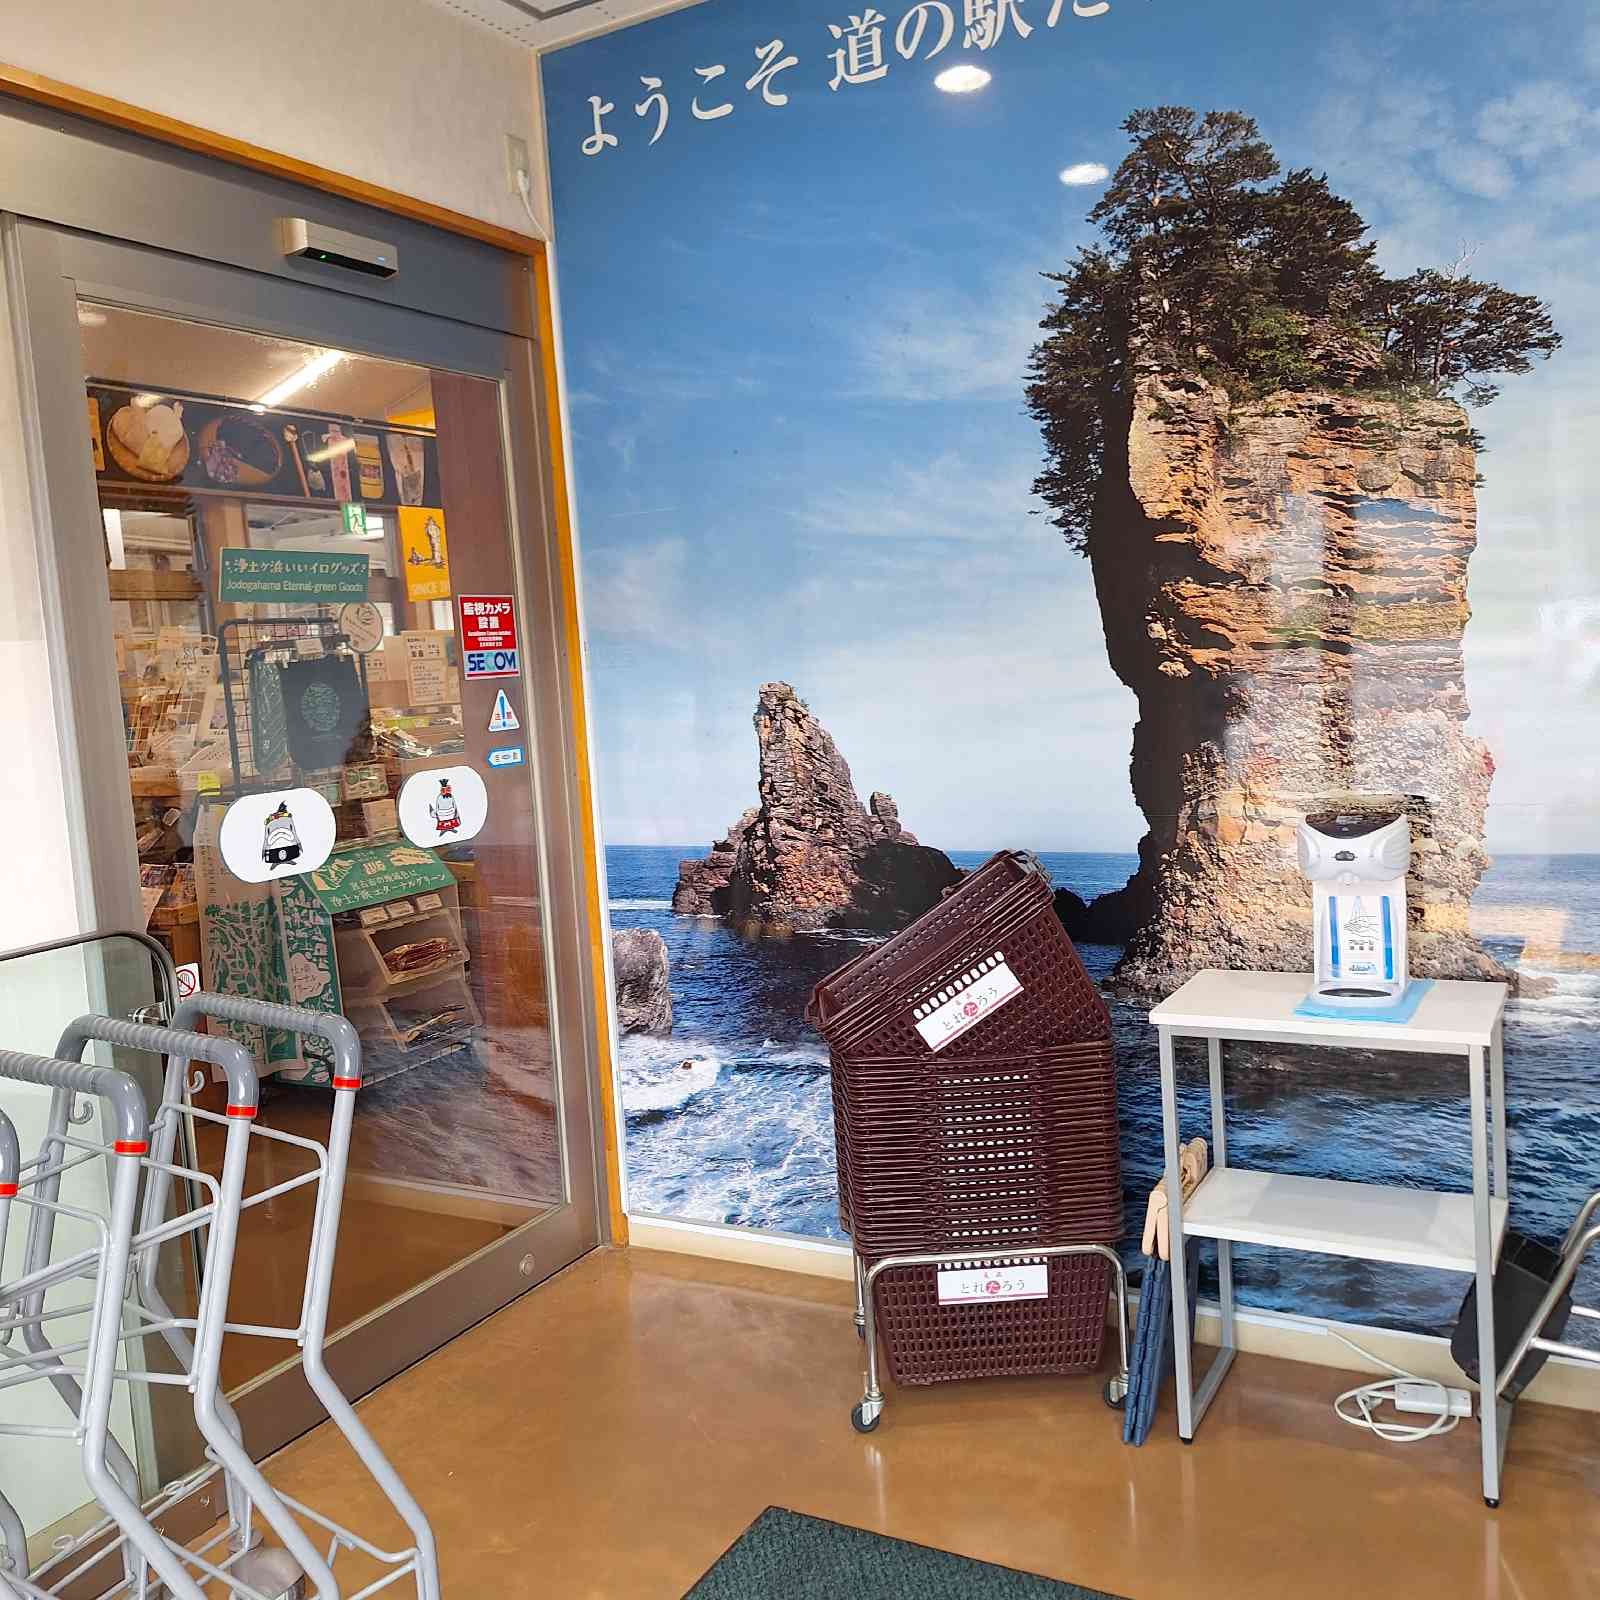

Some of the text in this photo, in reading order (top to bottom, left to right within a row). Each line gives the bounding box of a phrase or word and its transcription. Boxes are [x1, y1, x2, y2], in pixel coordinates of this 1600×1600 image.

[582, 39, 798, 156] ようこそ
[226, 579, 281, 593] Jodogahama
[339, 582, 364, 592] Goods
[463, 602, 511, 616] 監視カメラ
[467, 651, 516, 671] SECOM
[961, 1279, 1025, 1295] とれたろう
